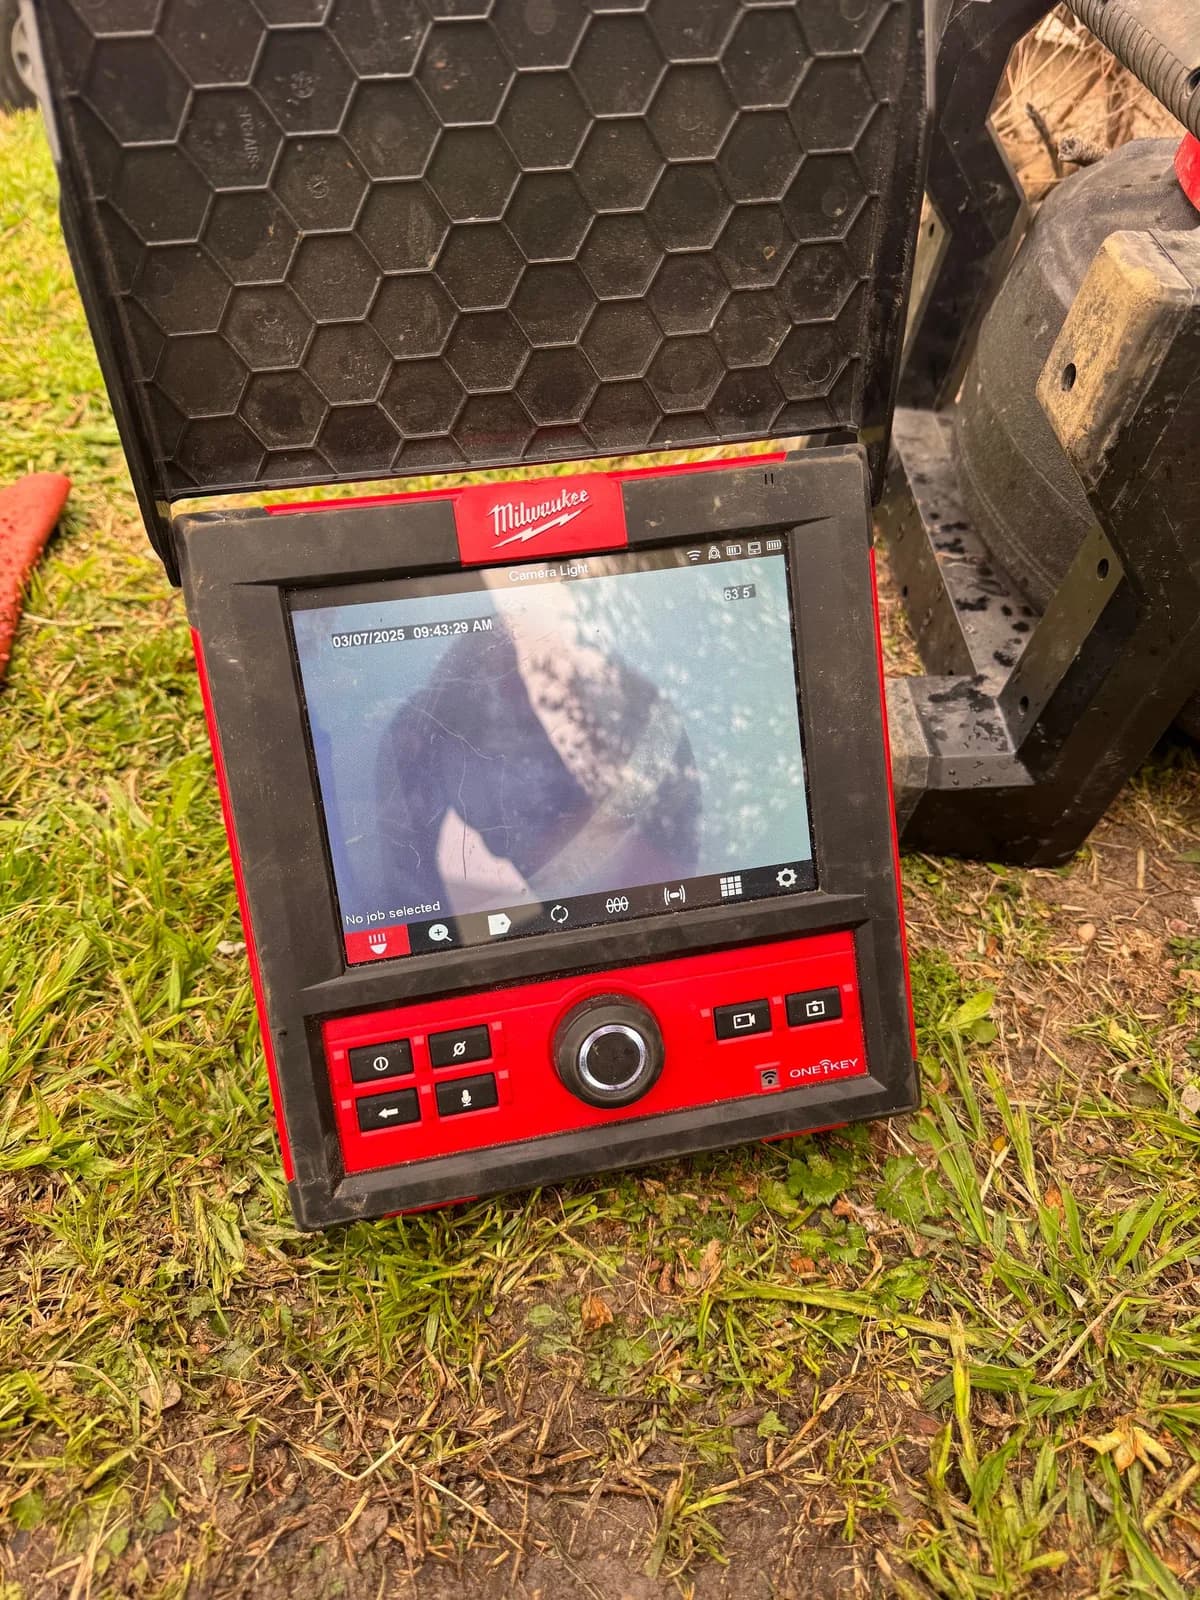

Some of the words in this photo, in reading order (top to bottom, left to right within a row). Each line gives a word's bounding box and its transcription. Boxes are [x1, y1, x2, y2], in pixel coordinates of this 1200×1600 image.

[487, 488, 590, 537] Milwaukee
[508, 568, 557, 582] Camera
[559, 563, 589, 577] Light
[332, 629, 405, 648] 03/07/2025
[413, 621, 469, 639] 09:43:29
[472, 618, 493, 633] AM
[345, 914, 364, 926] No
[366, 909, 386, 925] job
[389, 901, 441, 919] selected
